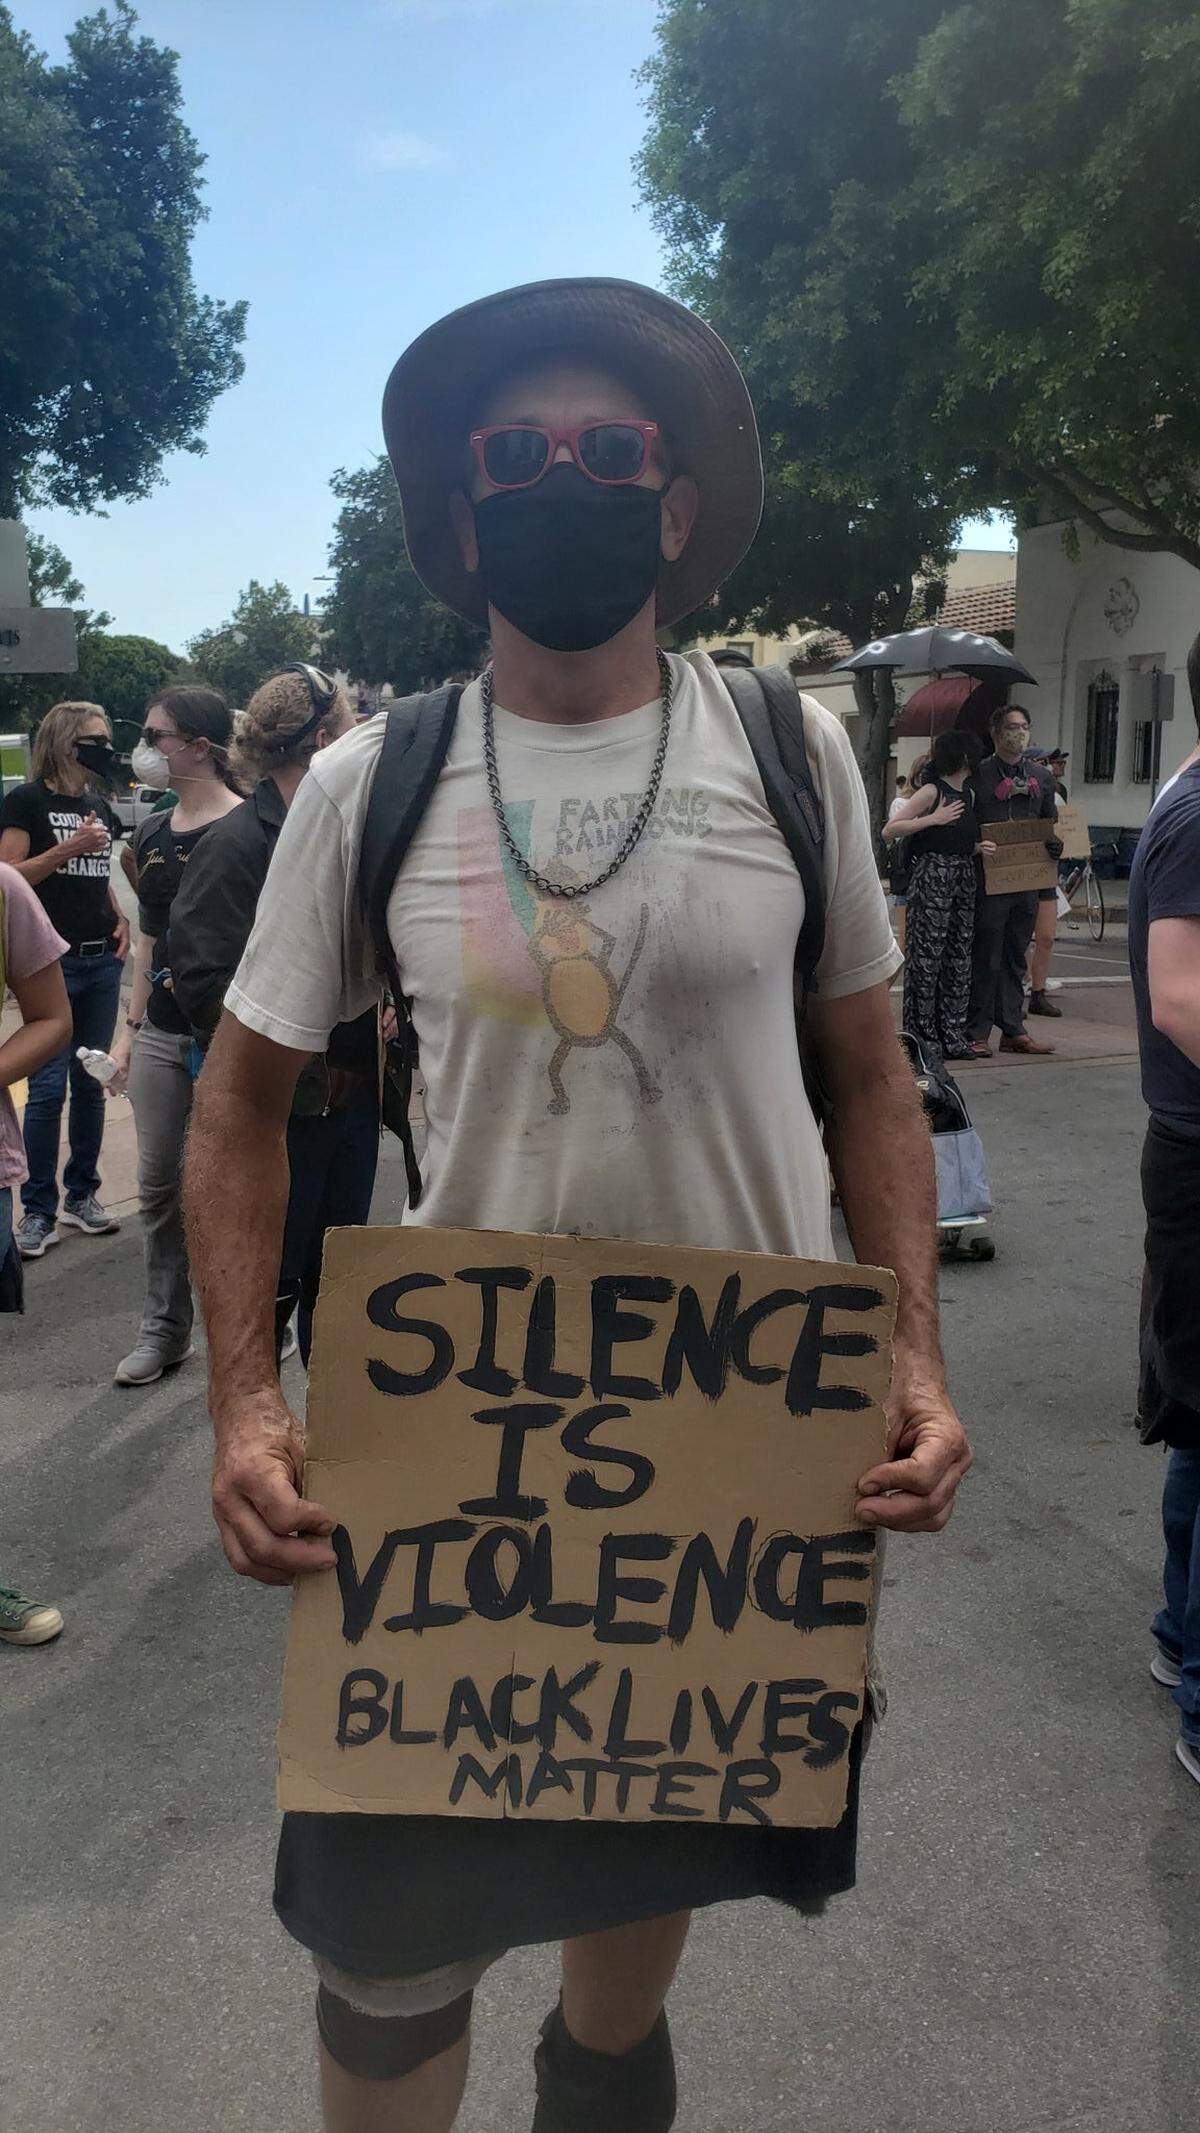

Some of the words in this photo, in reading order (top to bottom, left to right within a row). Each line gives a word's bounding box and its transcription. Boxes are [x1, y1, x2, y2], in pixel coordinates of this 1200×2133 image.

[366, 1266, 885, 1415] SILENCE
[457, 1403, 656, 1523] IS
[332, 1516, 876, 1647] VIOLENCE
[335, 1660, 603, 1752] BLACK
[602, 1667, 860, 1770] LIVES
[448, 1752, 782, 1825] MATTER
